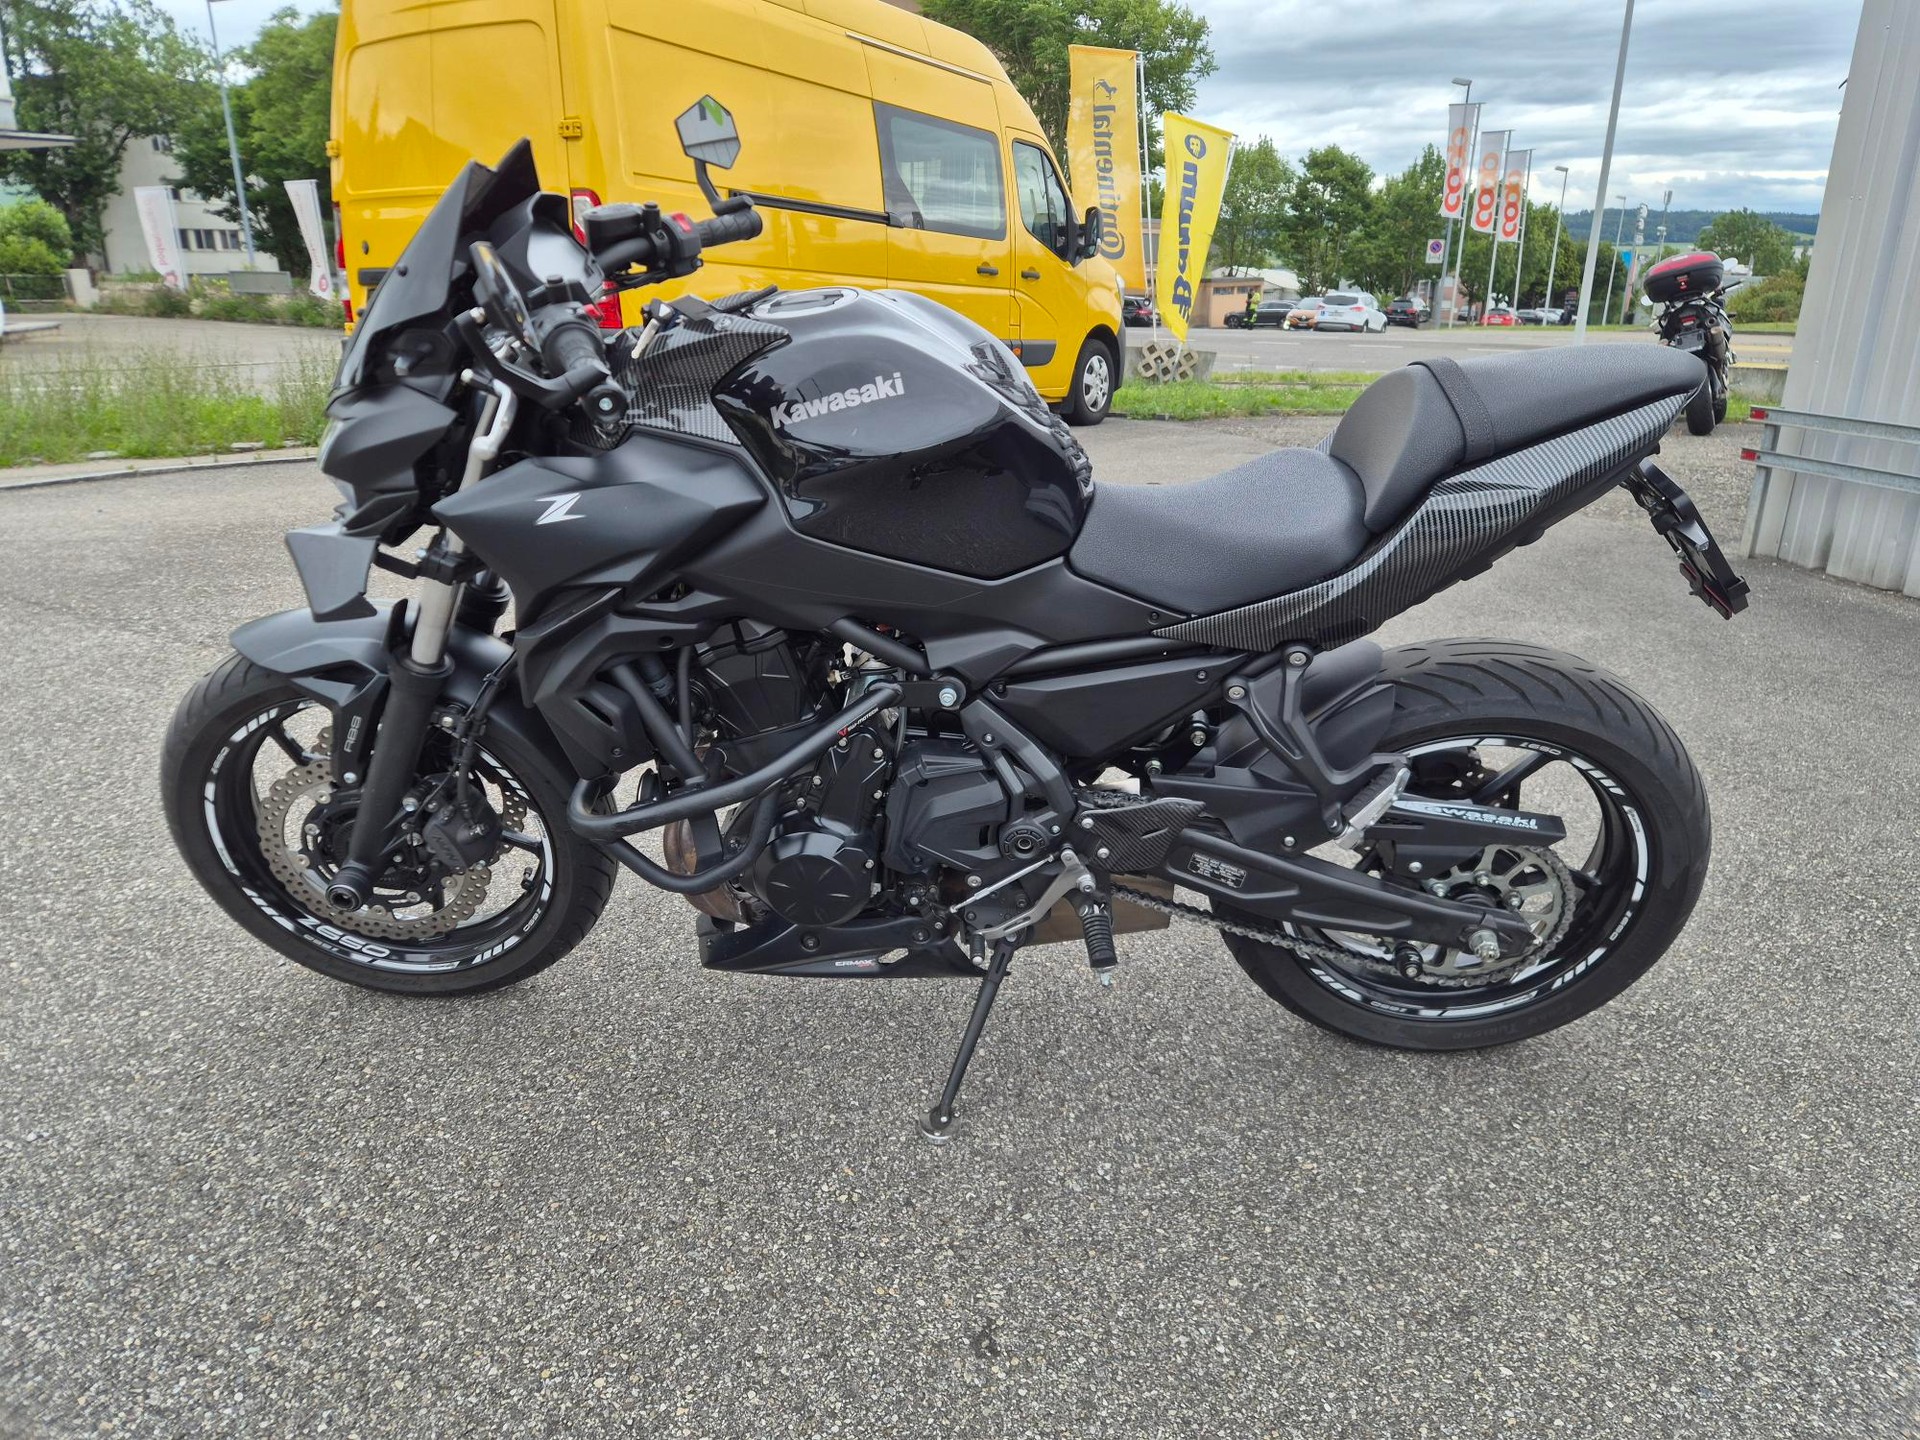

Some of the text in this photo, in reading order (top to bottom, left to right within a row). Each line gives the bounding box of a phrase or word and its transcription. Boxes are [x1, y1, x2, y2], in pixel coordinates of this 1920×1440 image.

[770, 373, 905, 428] Kawasaki
[534, 493, 586, 525] Z
[343, 715, 362, 753] ABS
[297, 917, 391, 958] Z650
